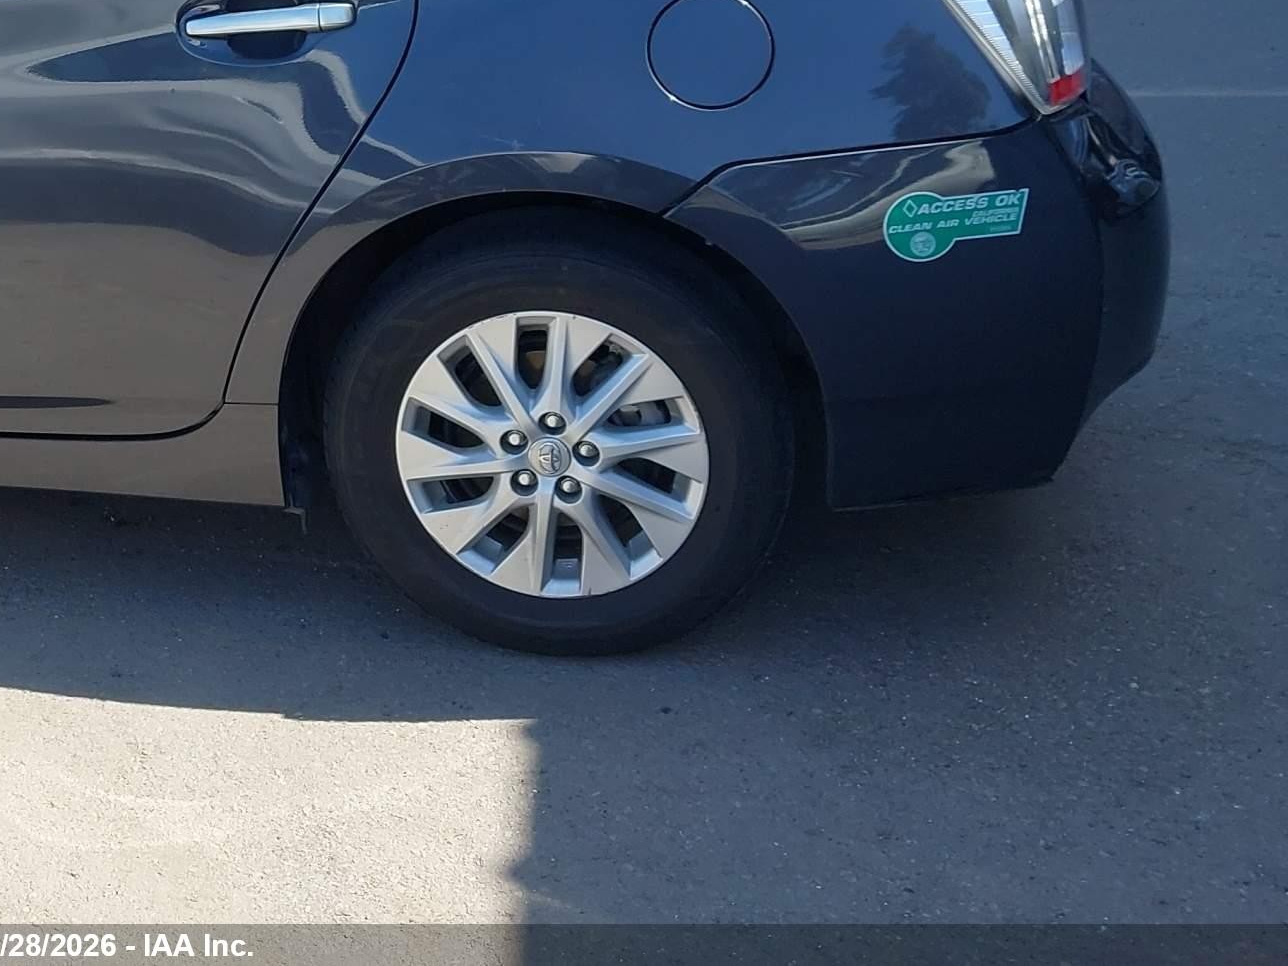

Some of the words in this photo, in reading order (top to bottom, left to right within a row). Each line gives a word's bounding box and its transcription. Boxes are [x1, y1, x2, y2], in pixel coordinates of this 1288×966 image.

[917, 197, 989, 215] ACCESS
[995, 193, 1021, 207] OK
[888, 222, 933, 234] CLEAN
[936, 219, 960, 229] AIR
[964, 212, 1017, 226] VEHICLE
